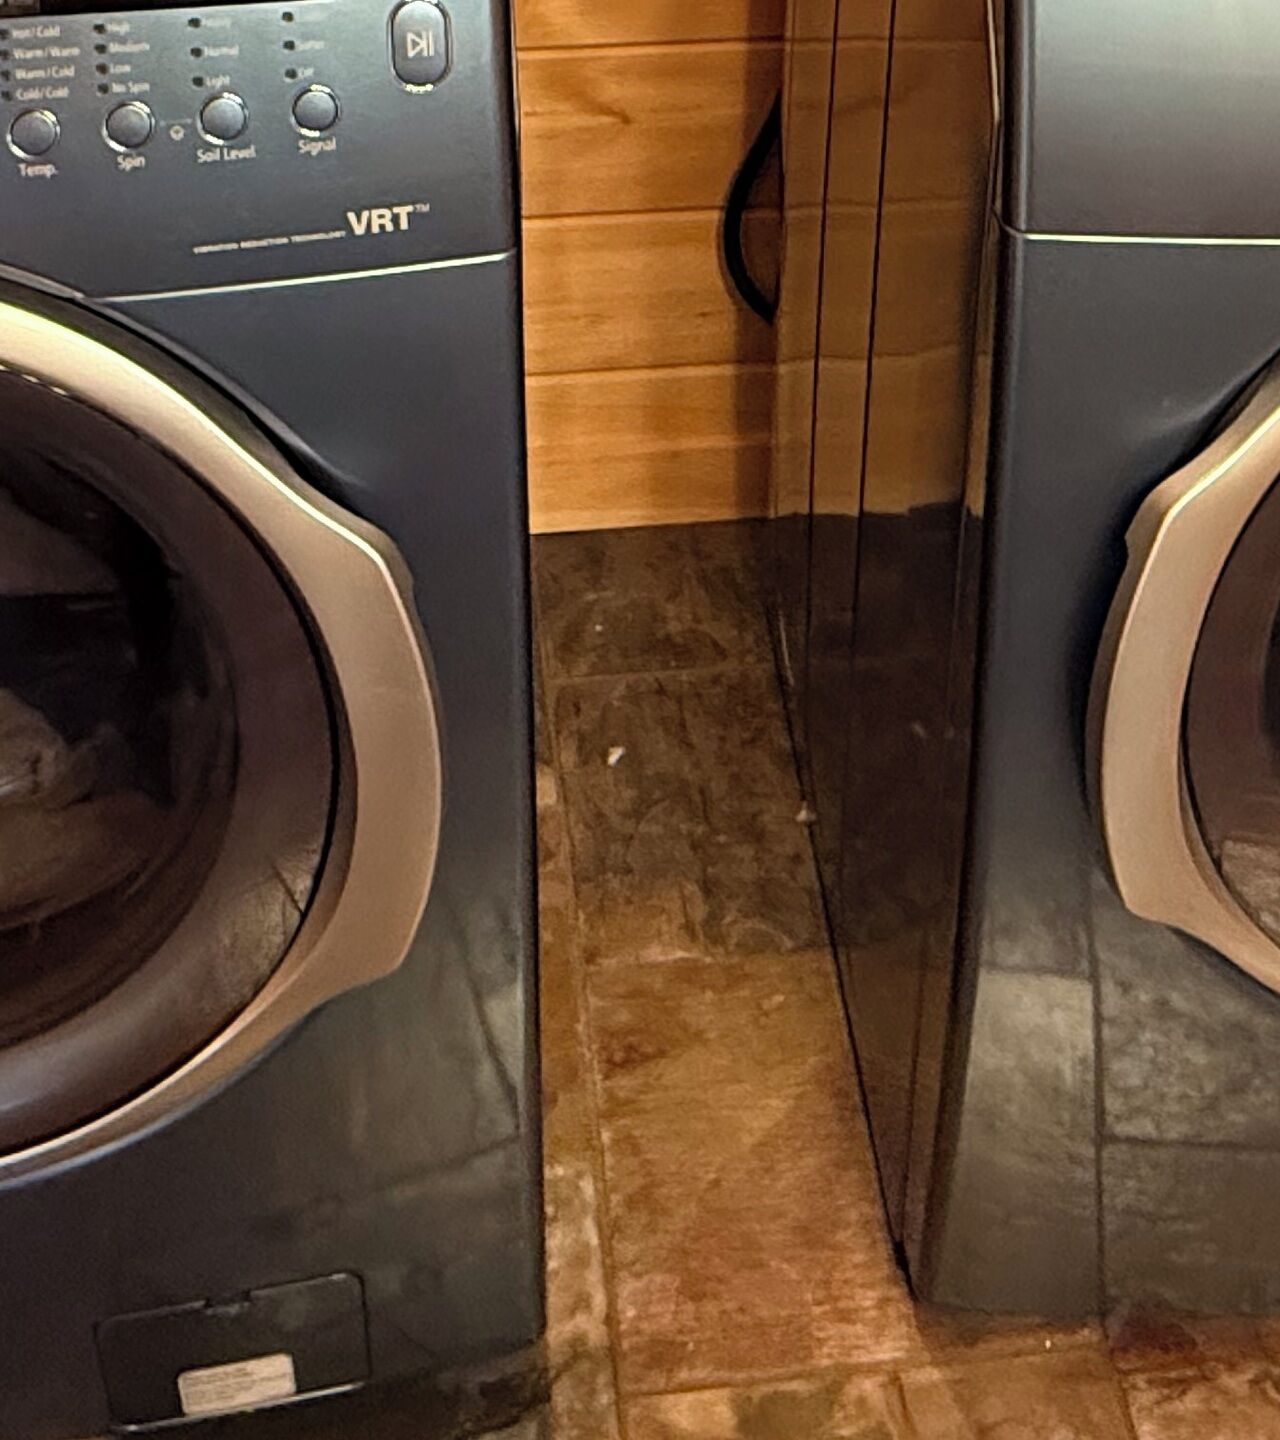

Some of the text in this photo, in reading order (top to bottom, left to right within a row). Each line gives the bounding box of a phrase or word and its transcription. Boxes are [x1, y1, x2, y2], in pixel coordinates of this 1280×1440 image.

[196, 144, 257, 165] Soil Level
[297, 137, 337, 157] Signal
[116, 152, 147, 173] Spin
